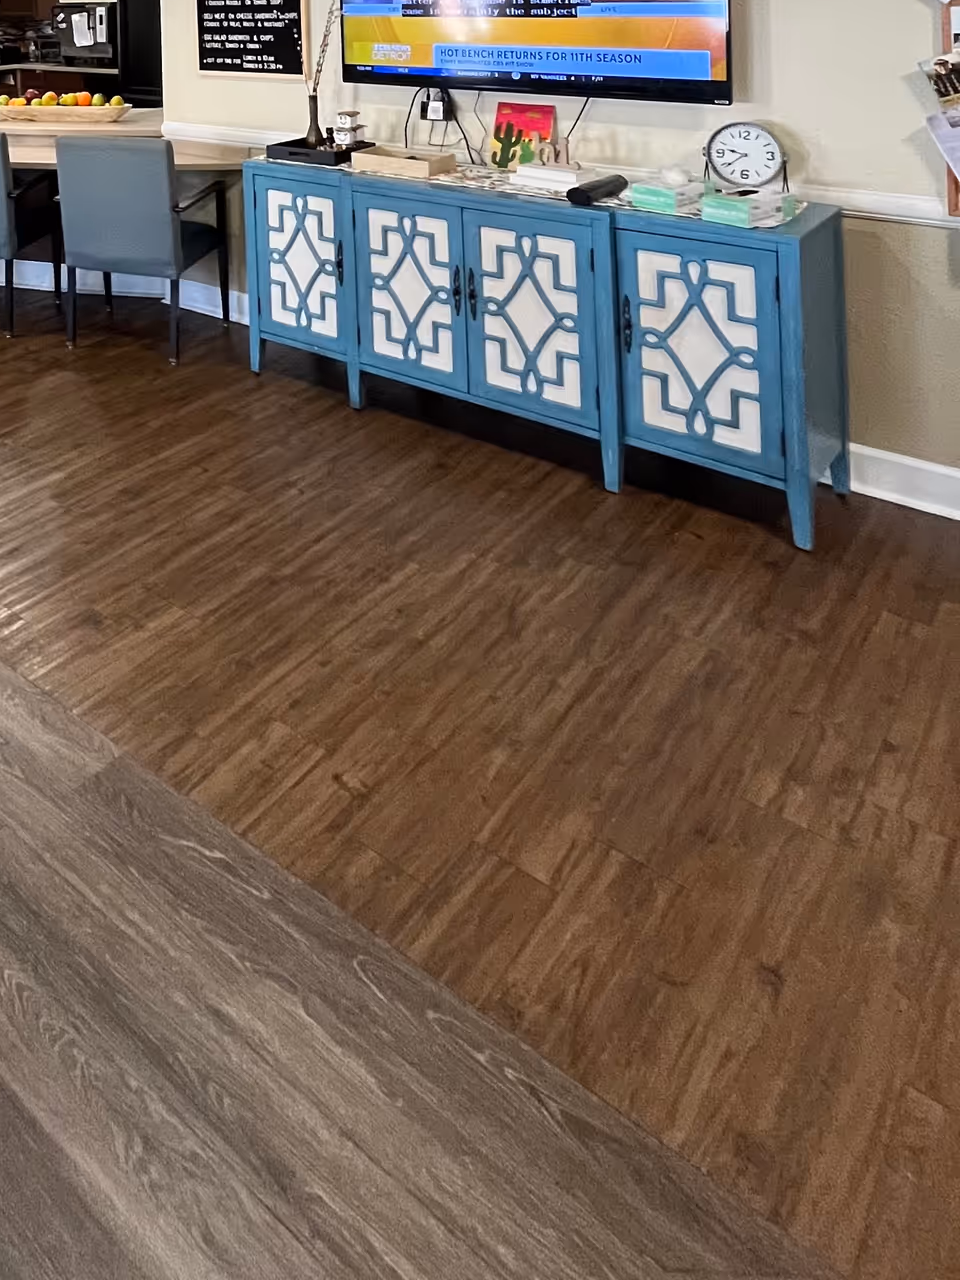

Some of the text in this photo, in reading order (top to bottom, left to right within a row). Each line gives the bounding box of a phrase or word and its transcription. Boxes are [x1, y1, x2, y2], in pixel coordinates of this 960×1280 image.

[401, 7, 424, 16] case
[505, 7, 524, 16] the
[530, 7, 577, 18] subject
[372, 51, 412, 60] DETROIT
[440, 48, 642, 64] HOT BENCH RETURNS FOR 11TH SEASON
[738, 130, 751, 141] 12
[715, 148, 776, 161] 9 3
[739, 169, 750, 180] 6
